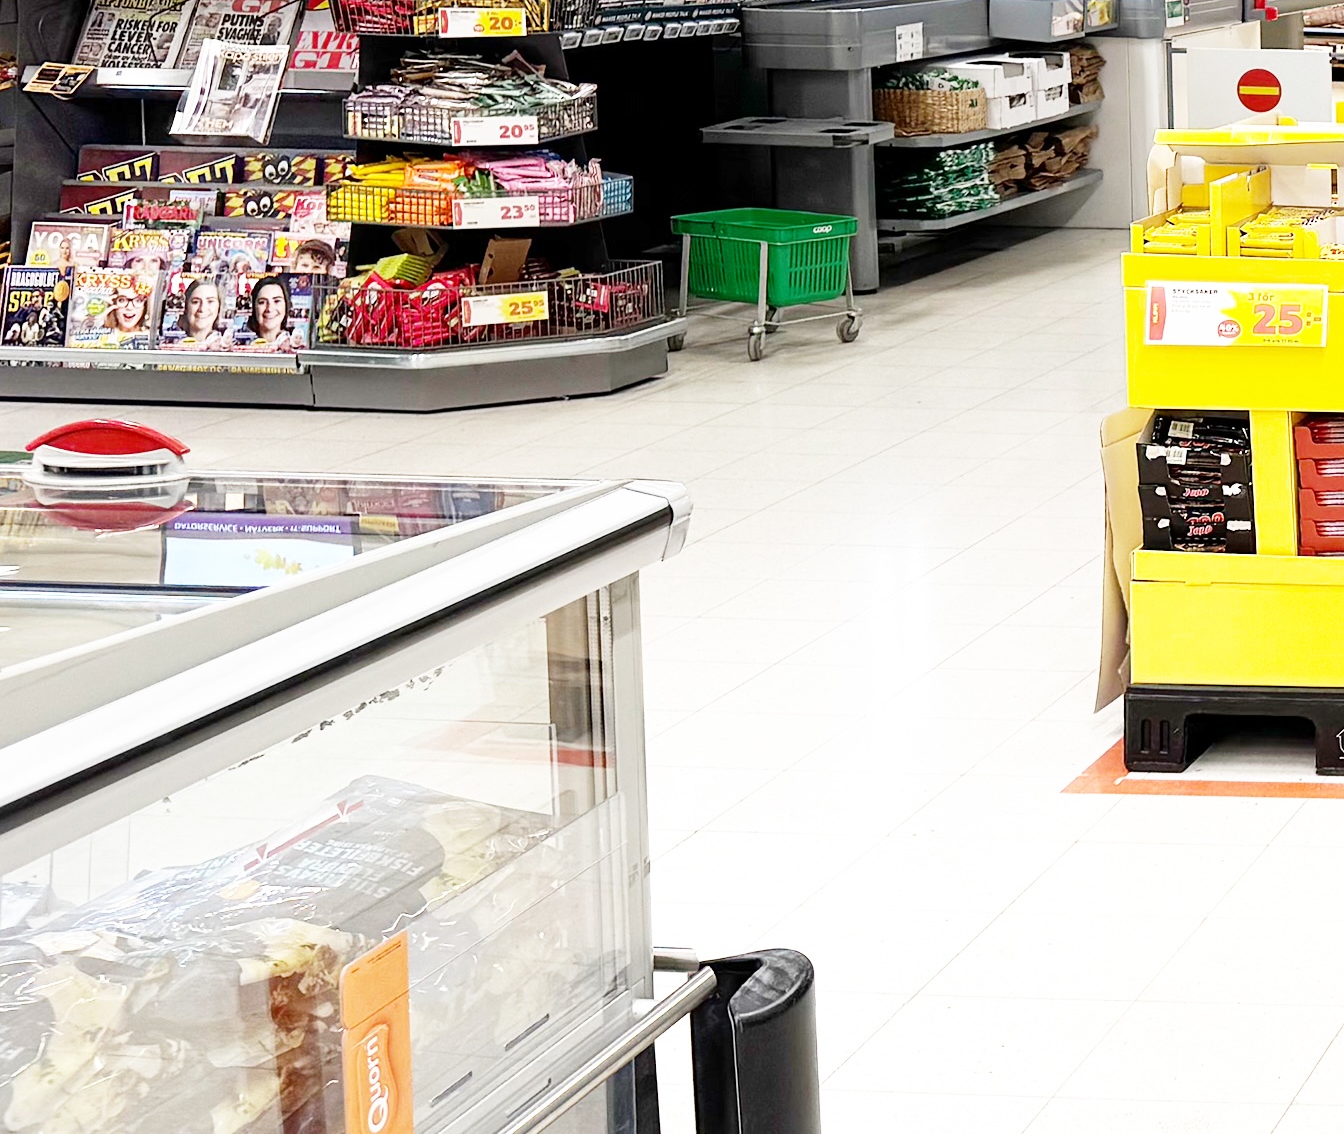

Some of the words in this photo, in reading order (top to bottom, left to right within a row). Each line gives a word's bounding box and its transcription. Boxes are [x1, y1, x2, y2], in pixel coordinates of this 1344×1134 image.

[115, 19, 155, 31] RISKEN
[222, 14, 264, 27] PUTINS
[108, 42, 151, 54] CANCER
[500, 206, 524, 220] 23
[812, 224, 832, 234] coop
[34, 231, 100, 251] YOGA
[112, 231, 170, 252] KRYSS
[75, 273, 131, 289] KRYSS
[1248, 292, 1255, 301] 3
[1257, 292, 1275, 301] för
[508, 302, 533, 316] 25
[367, 1035, 389, 1134] Quorn
